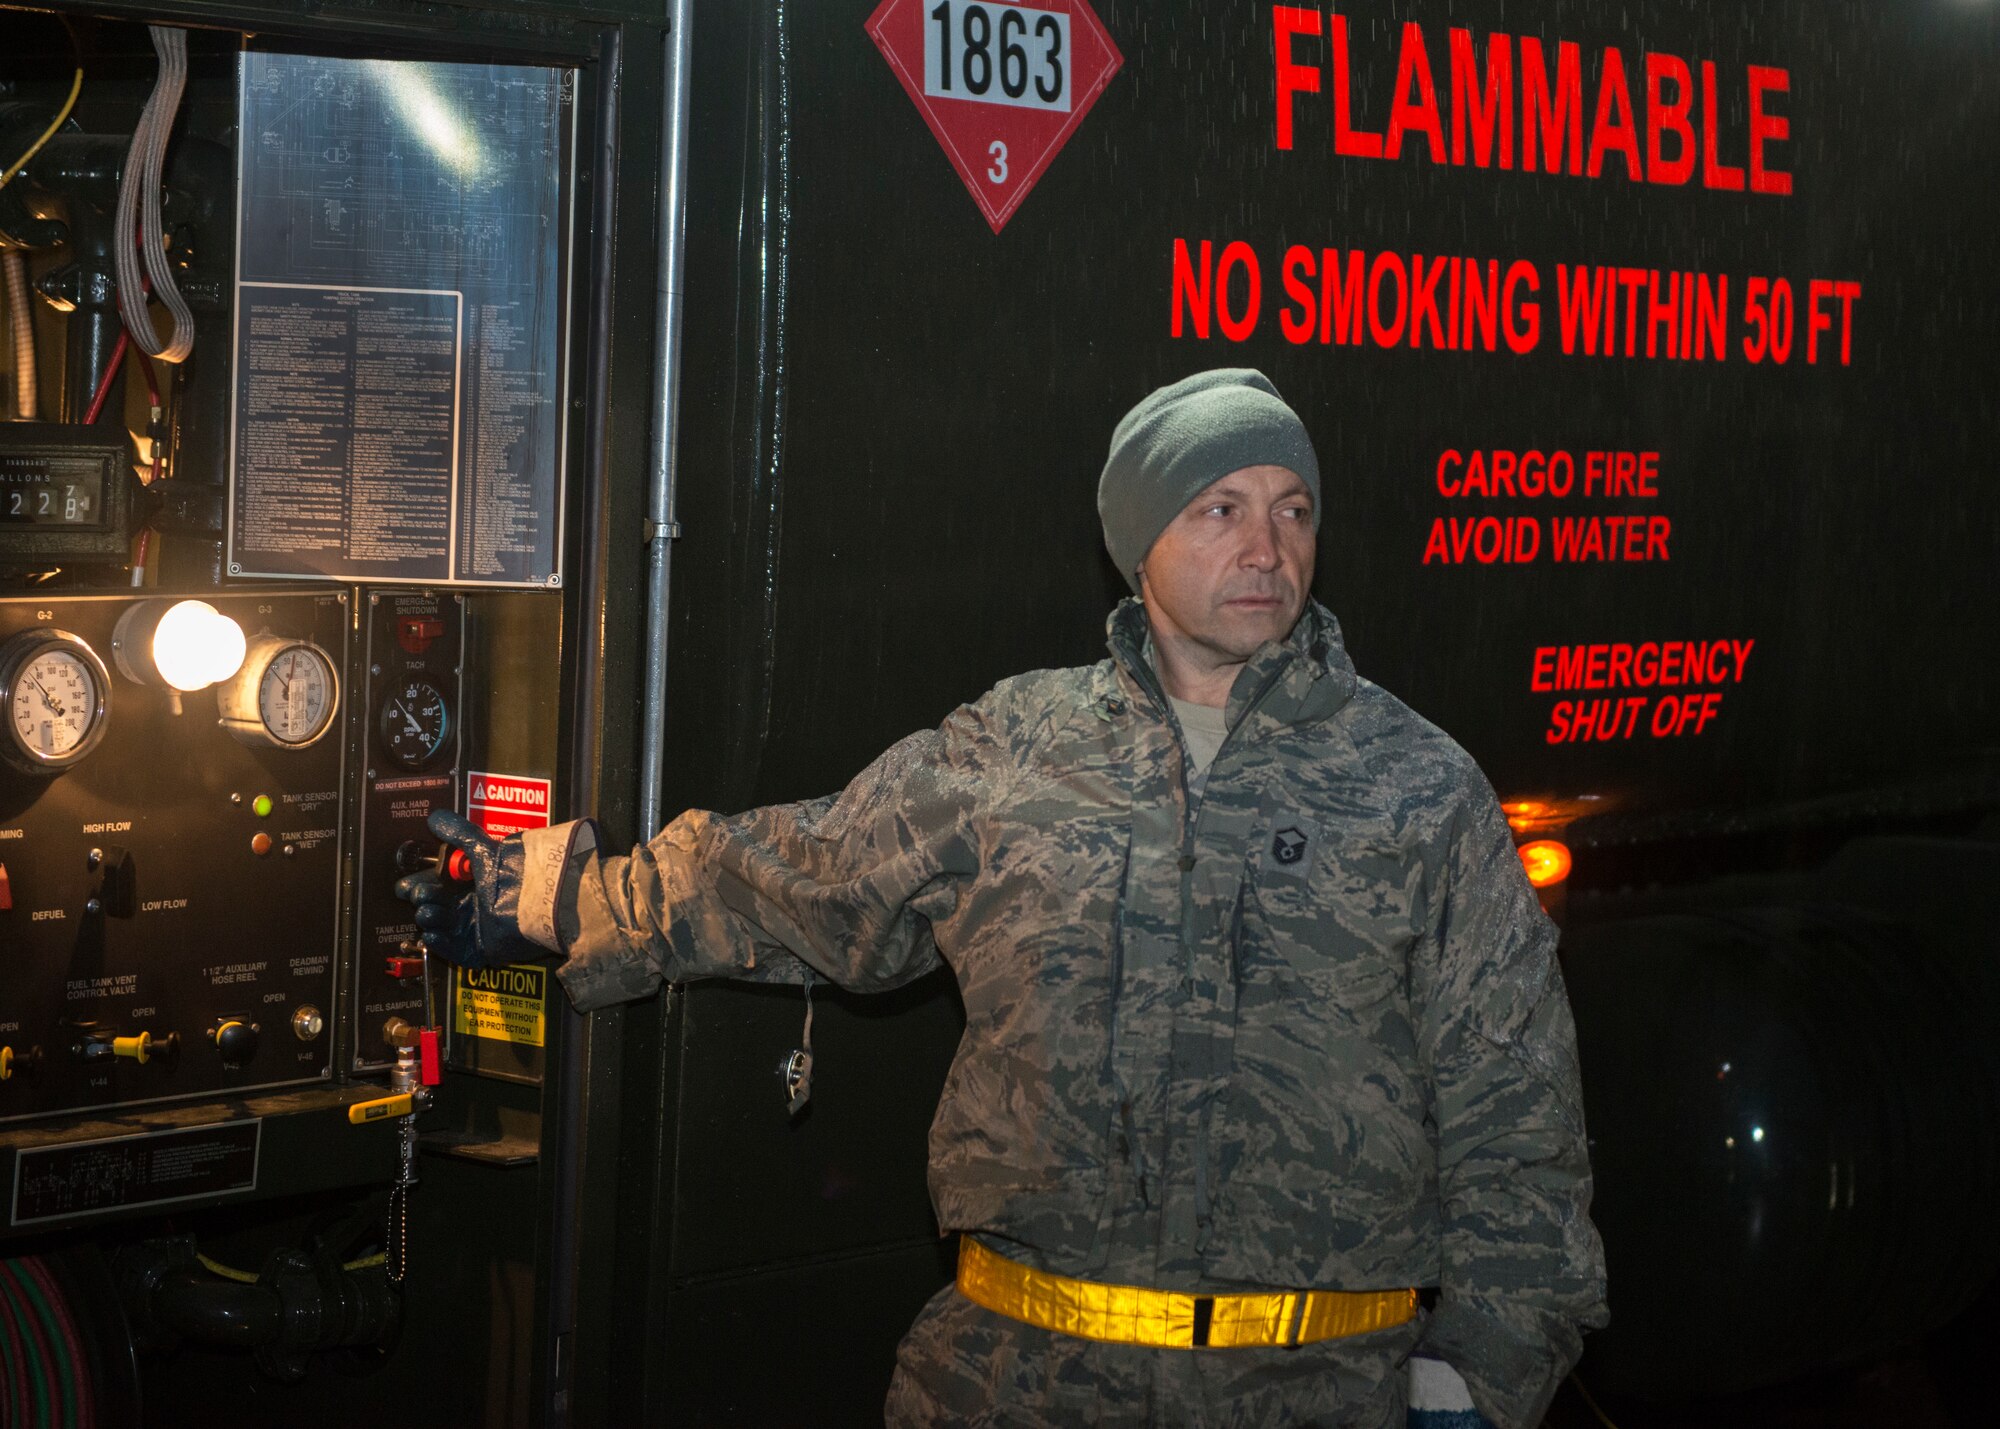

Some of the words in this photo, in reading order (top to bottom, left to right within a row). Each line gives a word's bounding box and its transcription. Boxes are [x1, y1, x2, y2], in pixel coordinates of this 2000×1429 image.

[932, 0, 1063, 103] 1863
[1273, 5, 1793, 195] FLAMMABLE
[988, 140, 1008, 184] 3
[1171, 238, 1262, 341] NO
[1279, 244, 1540, 354] SMOKING
[1557, 264, 1727, 361] WITHIN
[1743, 277, 1794, 363] 50
[1808, 280, 1863, 366] FT
[1436, 450, 1575, 498] CARGO
[1584, 452, 1660, 497] FIRE
[1423, 516, 1541, 565] AVOID
[1552, 515, 1671, 562] WATER
[395, 597, 440, 606] EMERGENCY
[37, 610, 53, 620] G-2
[258, 605, 272, 614] G-3
[396, 606, 438, 615] SHUTDOWN
[47, 667, 56, 675] 100
[406, 661, 425, 670] TACH
[1531, 639, 1754, 693] EMERGENCY
[59, 670, 68, 678] 120
[67, 680, 76, 688] 140
[72, 692, 81, 700] 160
[406, 690, 417, 698] 20
[72, 706, 80, 714] 180
[389, 710, 398, 718] 10
[422, 708, 433, 716] 30
[1546, 694, 1643, 744] SHUT
[1651, 691, 1724, 738] OFF
[394, 735, 400, 743] 0
[419, 733, 430, 742] 40
[398, 780, 421, 788] EXCEED
[282, 794, 304, 803] TANK
[304, 792, 337, 802] SENSOR
[487, 783, 545, 805] CAUTION
[391, 802, 407, 810] AUX.
[408, 800, 430, 809] HAND
[391, 808, 428, 818] THROTTLE
[83, 824, 104, 834] HIGH
[106, 822, 132, 832] FLOW
[486, 823, 516, 834] INCREASE
[280, 832, 302, 840] TANK
[304, 829, 336, 839] SENSOR
[142, 900, 162, 911] LOW
[163, 898, 187, 910] FLOW
[32, 910, 66, 921] DEFUEL
[375, 926, 394, 935] TANK
[396, 923, 418, 933] LEVEL
[378, 933, 415, 944] OVERRIDE
[290, 955, 329, 967] DEADMAN
[226, 961, 268, 974] AUXILIARY
[293, 966, 324, 976] REWIND
[66, 980, 88, 990] FUEL
[91, 978, 114, 988] TANK
[115, 975, 137, 984] VENT
[212, 975, 235, 985] HOSE
[236, 972, 258, 983] REEL
[468, 968, 536, 996] CAUTION
[66, 988, 108, 1000] CONTROL
[110, 984, 136, 996] VALVE
[263, 992, 286, 1003] OPEN
[366, 1004, 384, 1013] FUEL
[385, 999, 422, 1012] SAMPLING
[462, 991, 472, 1000] DO
[474, 993, 489, 1002] NOT
[490, 996, 523, 1008] OPERATE
[525, 1001, 541, 1011] THIS
[132, 1007, 156, 1018] OPEN
[464, 1004, 504, 1017] EQUIPMENT
[505, 1010, 538, 1023] WITHOUT
[470, 1018, 484, 1028] EAR
[486, 1021, 532, 1036] PROTECTION
